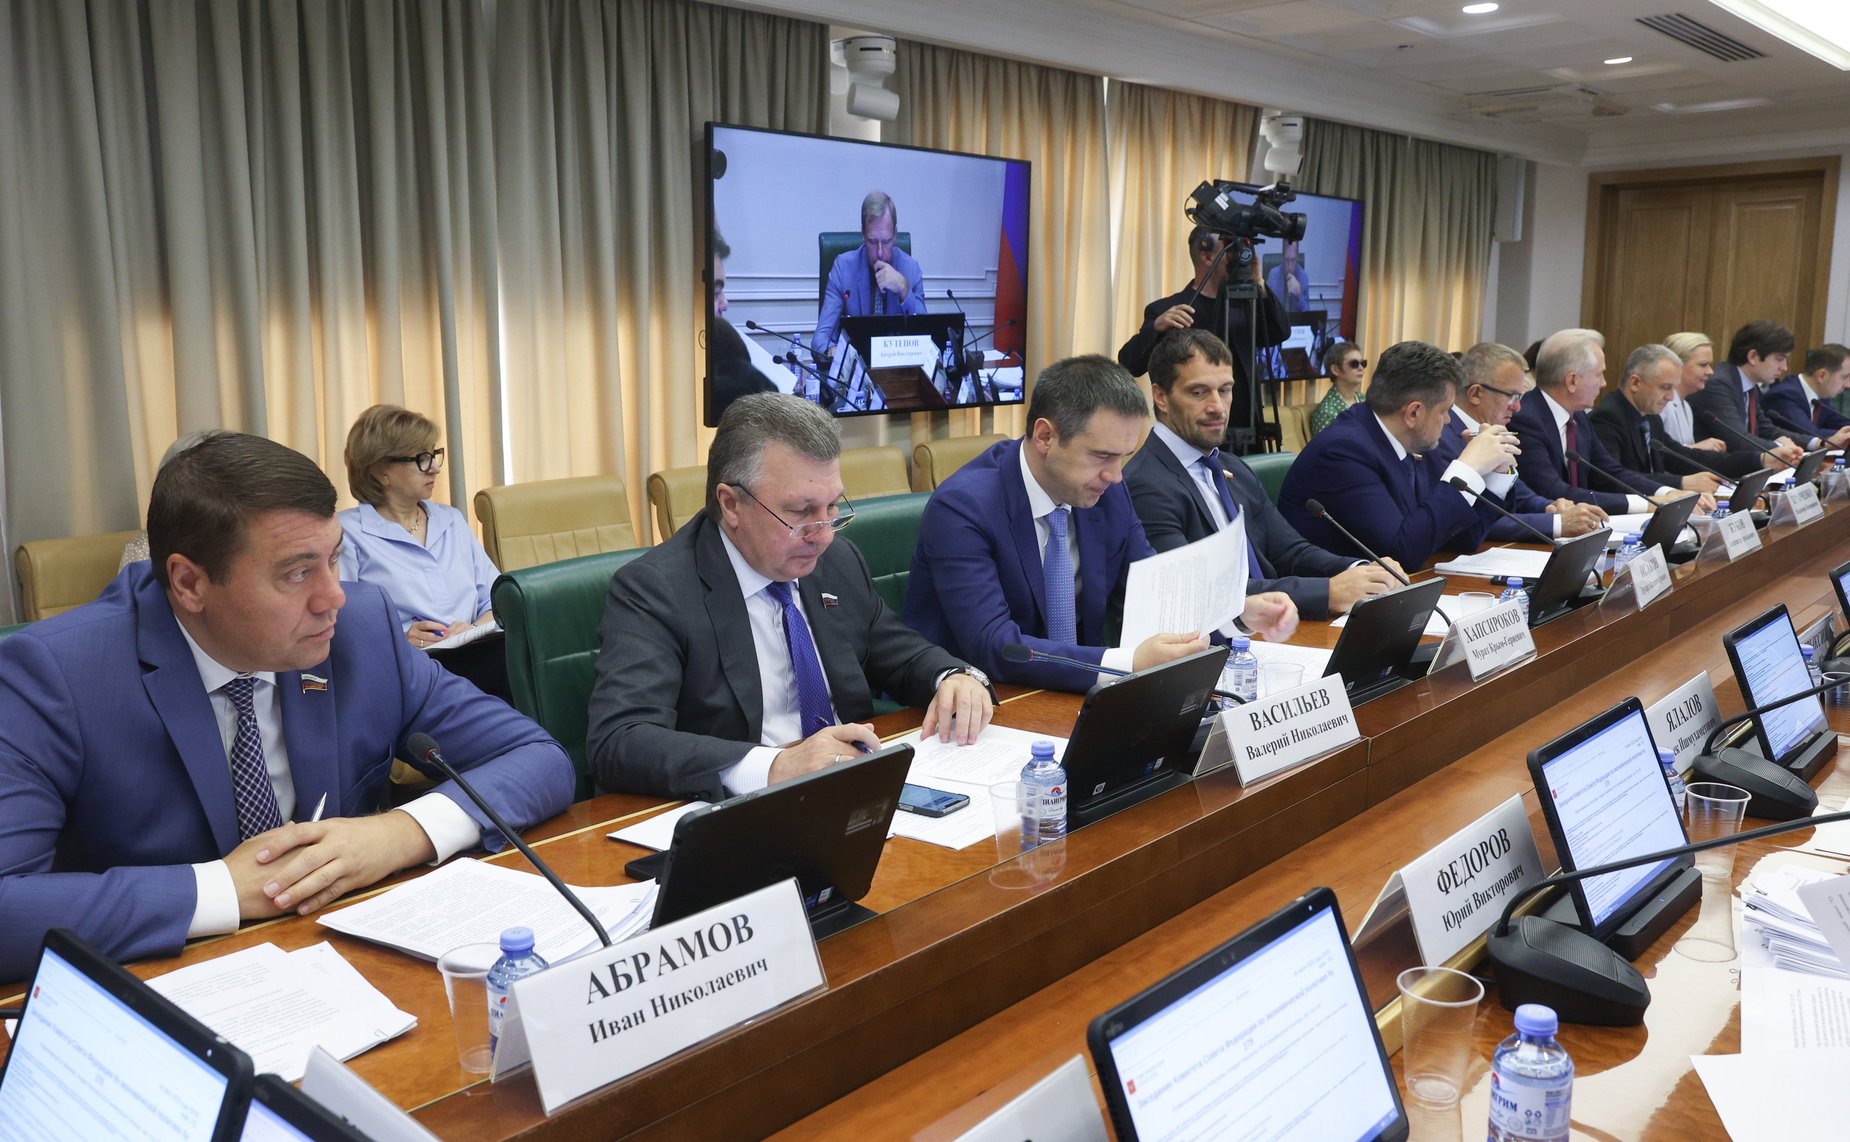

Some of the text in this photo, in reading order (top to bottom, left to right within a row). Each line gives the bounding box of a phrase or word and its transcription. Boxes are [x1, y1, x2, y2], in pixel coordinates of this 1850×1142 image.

[883, 339, 920, 348] КУТЕПОВ
[1463, 608, 1521, 644] ХАПСИРОКОВ
[1471, 645, 1490, 661] Мурат
[1248, 688, 1331, 732] ВАСИЛЬЕВ
[1665, 694, 1704, 733] ЯЛАЛОВ
[1245, 714, 1349, 761] Валерий Николаевич
[1436, 828, 1511, 895] ФЕДОРОВ
[1441, 864, 1525, 933] Юрий Викторович
[586, 914, 754, 1005] АБРАМОВ
[588, 957, 769, 1045] Иван Николаевич
